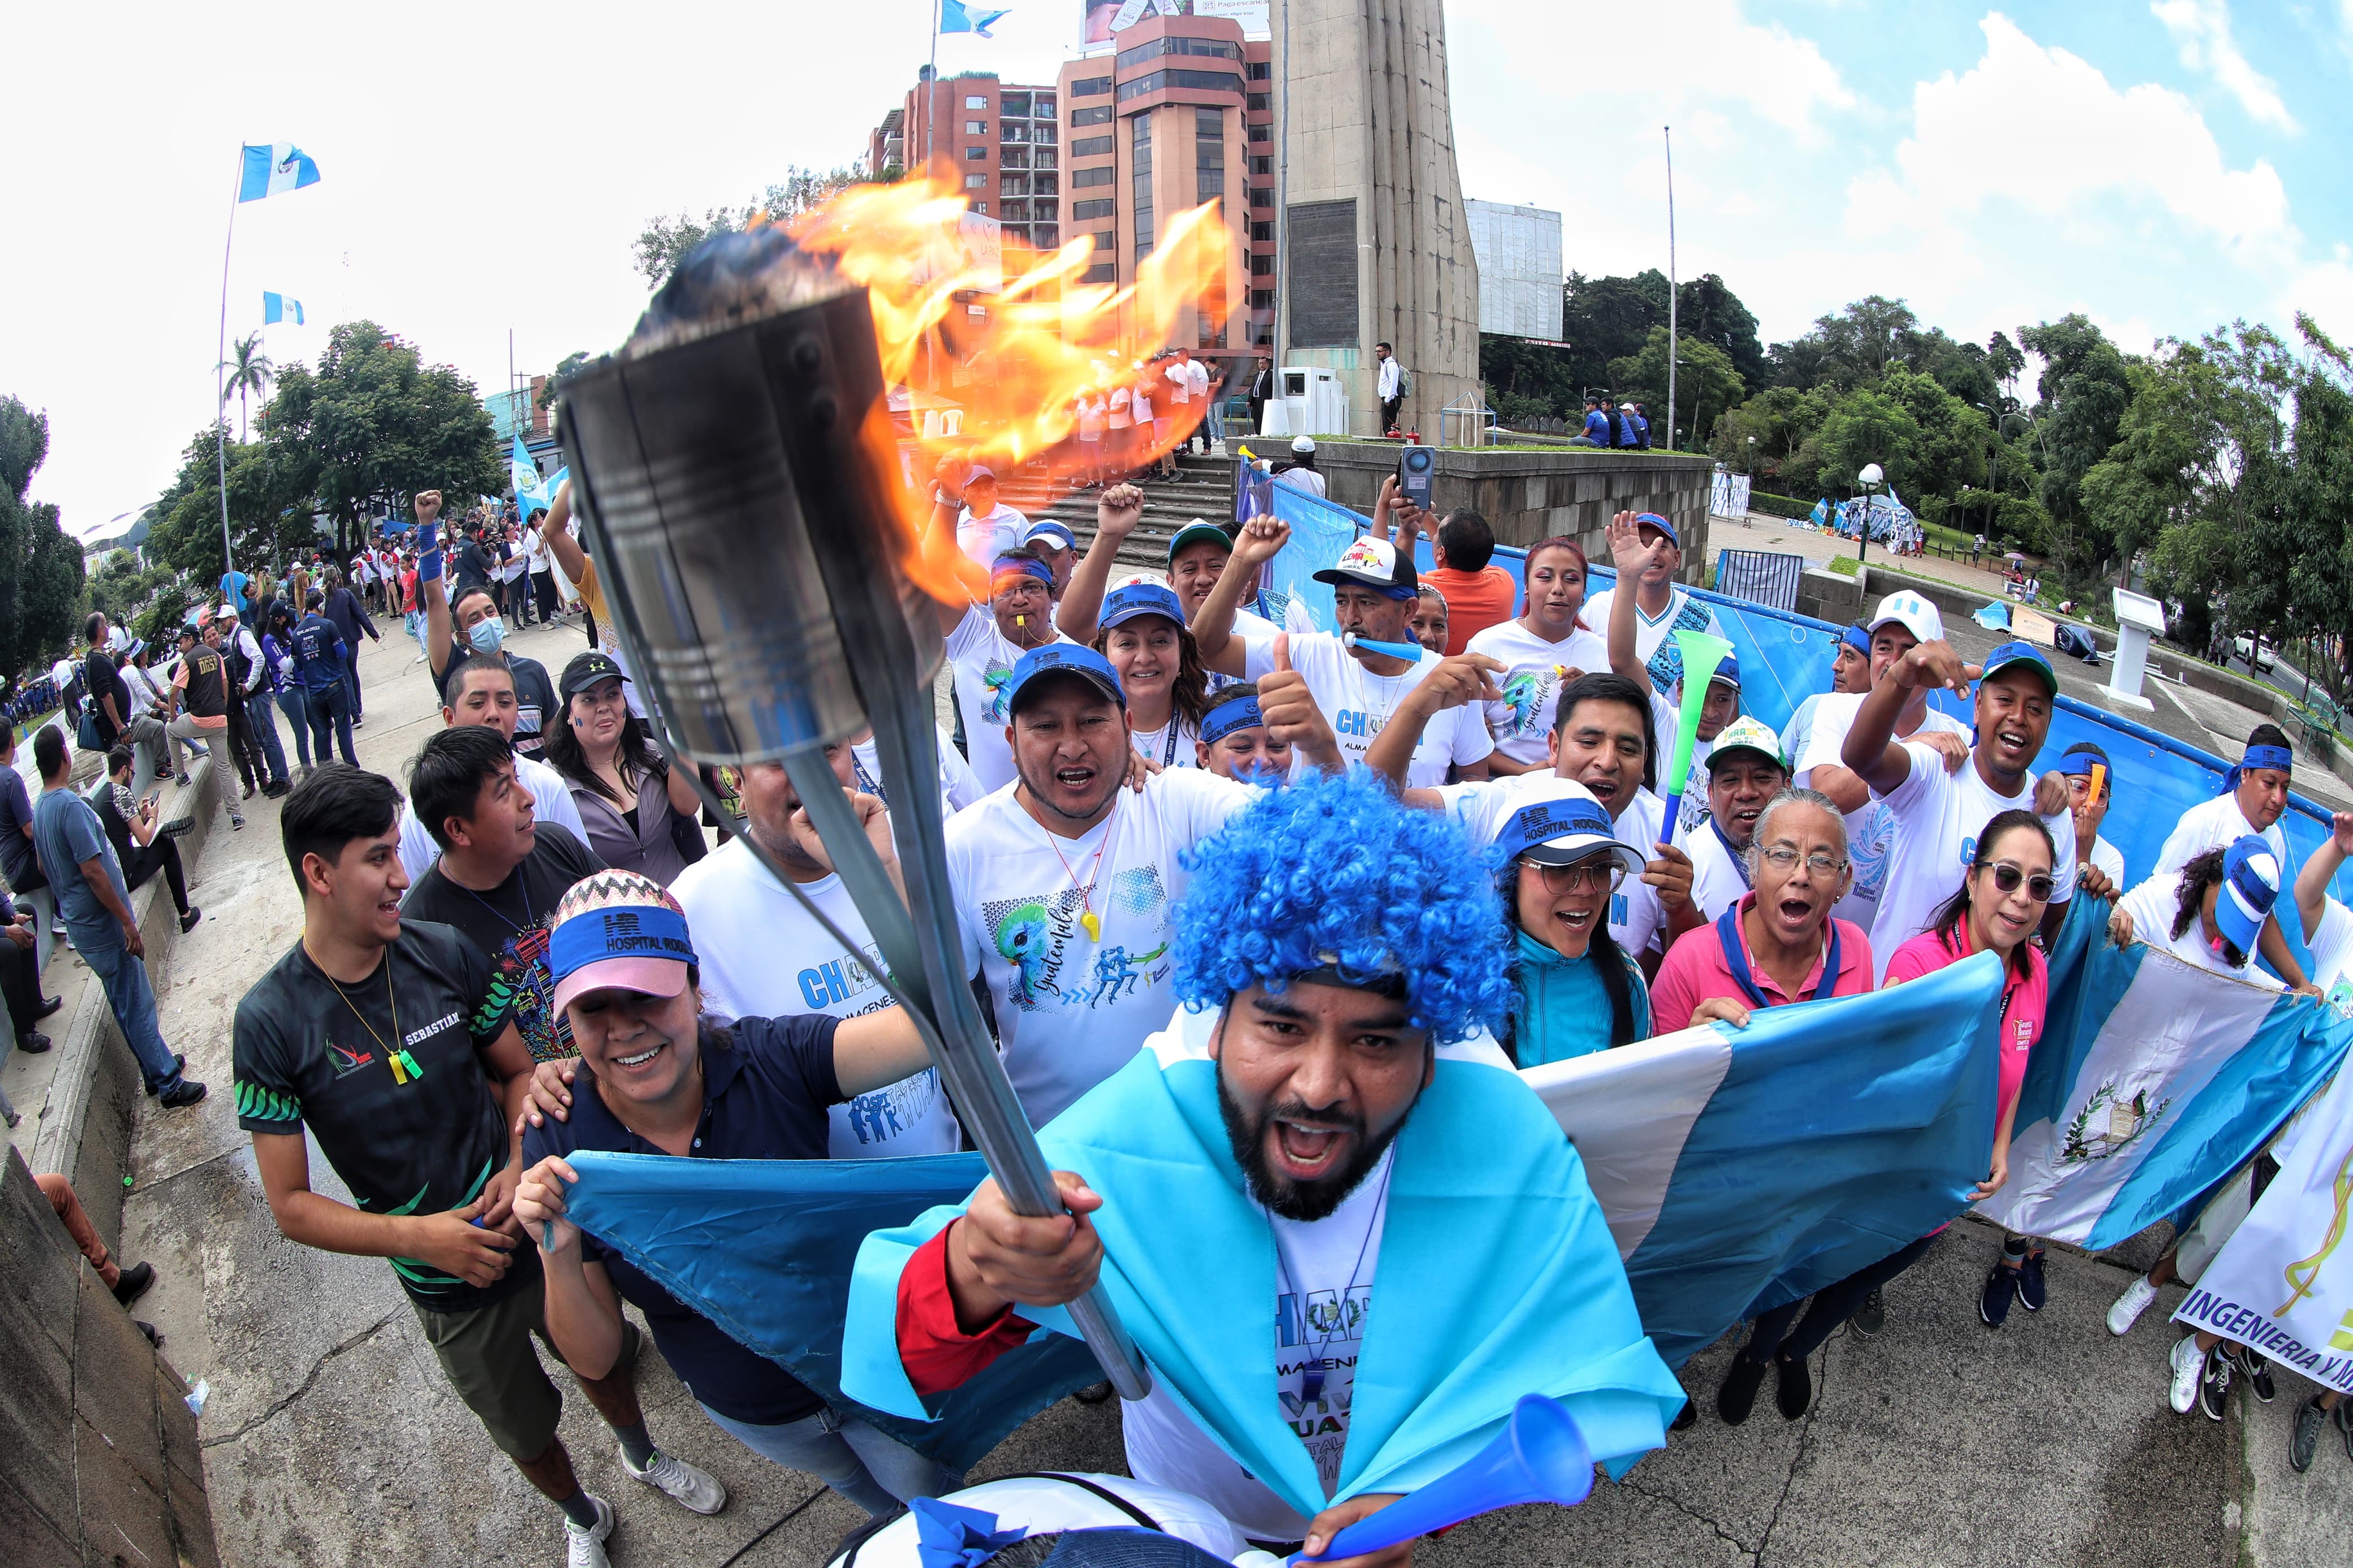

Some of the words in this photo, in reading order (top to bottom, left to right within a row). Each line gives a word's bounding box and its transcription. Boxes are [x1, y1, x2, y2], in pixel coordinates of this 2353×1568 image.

[1109, 601, 1136, 615] HOSPITAL
[1138, 601, 1174, 613] ROOSEVELT
[1224, 715, 1262, 732] ROOSEVEL
[1729, 728, 1761, 738] BRASIL
[1524, 820, 1571, 843] HOSPITAL
[606, 936, 663, 952] HOSPITAL
[404, 1012, 460, 1046] SEBASTIÁN
[2179, 1289, 2321, 1370] INGENIERIA
[2317, 1357, 2342, 1376] Y
